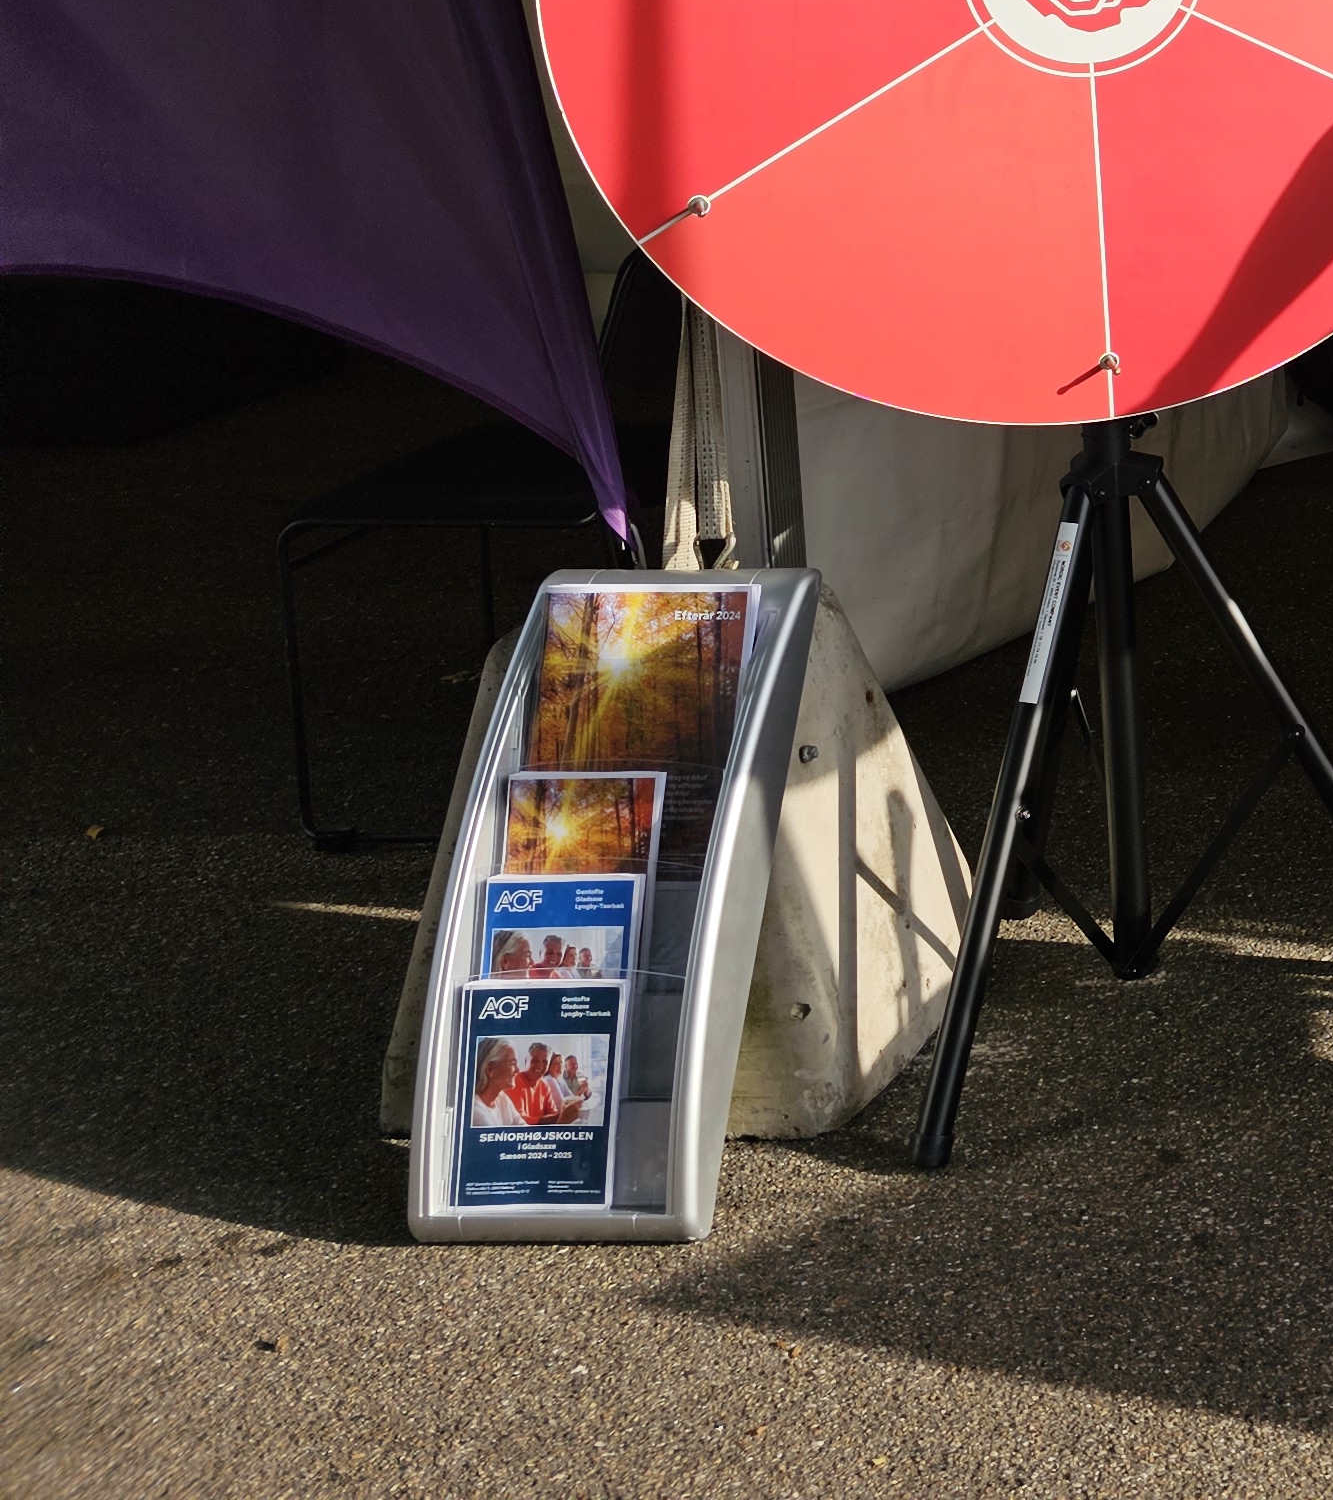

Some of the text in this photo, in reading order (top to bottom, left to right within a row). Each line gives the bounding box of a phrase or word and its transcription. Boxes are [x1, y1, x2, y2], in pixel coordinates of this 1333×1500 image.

[1058, 560, 1066, 580] NORDIC
[1053, 581, 1061, 599] EVENT
[674, 609, 741, 621] Efterår 2024
[1046, 600, 1057, 627] COMPANY
[493, 889, 543, 912] AOF
[478, 995, 529, 1019] AOF
[479, 1131, 594, 1143] SENIORHØJSKOLEN
[499, 1152, 527, 1160] Sæson
[527, 1152, 547, 1160] 2024
[553, 1151, 572, 1159] 2025
